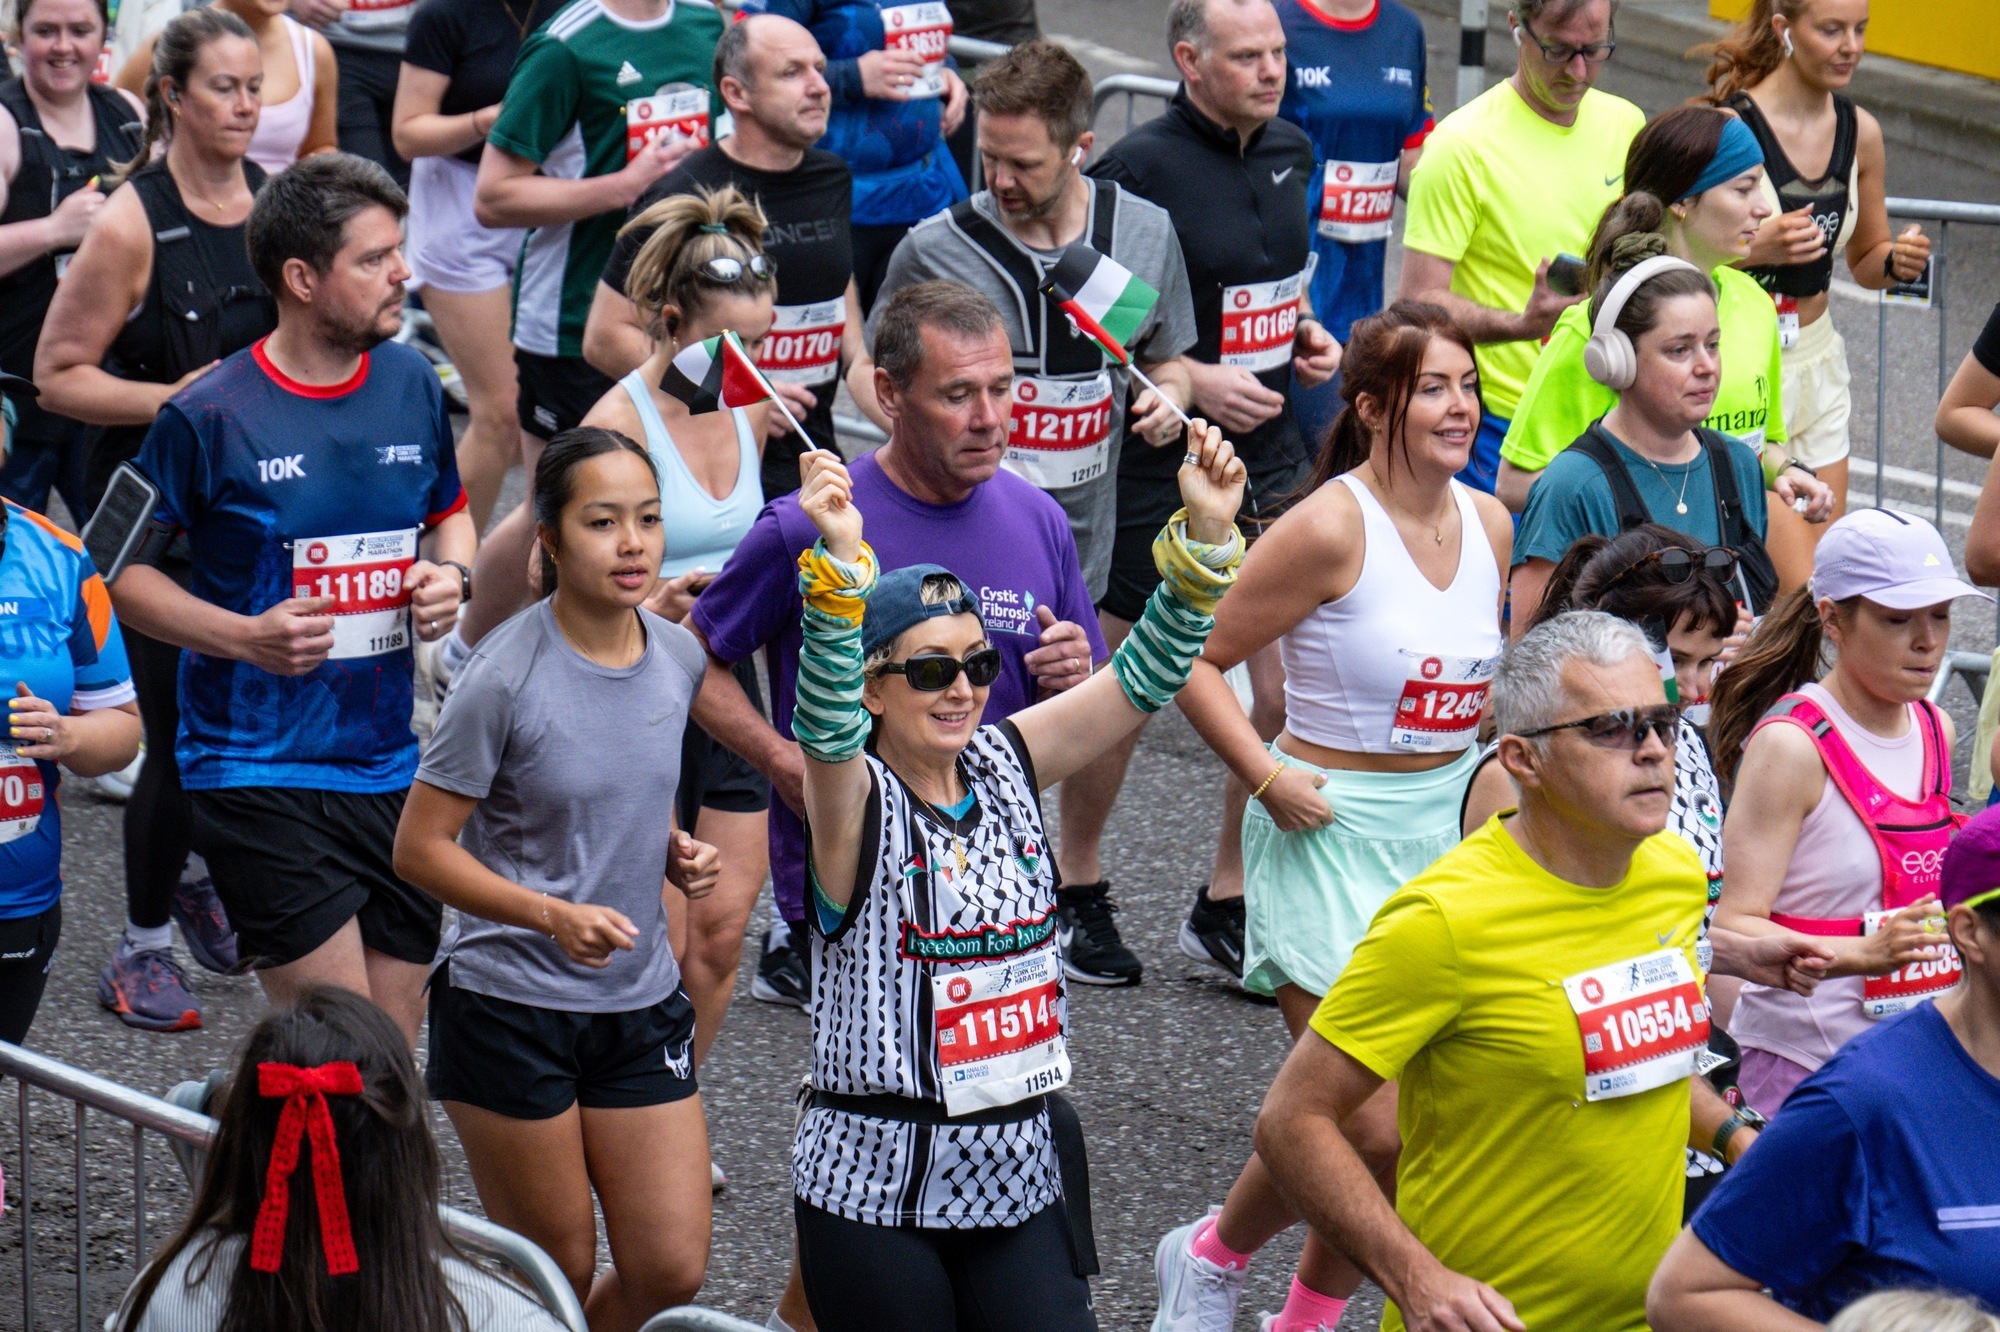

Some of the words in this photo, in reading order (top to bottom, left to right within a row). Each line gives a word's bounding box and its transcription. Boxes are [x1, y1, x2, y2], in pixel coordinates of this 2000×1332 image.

[1295, 65, 1332, 88] 10K
[1241, 305, 1297, 343] 10169
[762, 331, 834, 361] 10170
[1022, 407, 1102, 440] 12171
[257, 454, 307, 483] 10K
[1071, 463, 1102, 483] 12171
[310, 548, 325, 560] 10K
[315, 567, 402, 602] 11189
[980, 586, 1019, 604] Cystic
[982, 601, 1031, 621] Fibrosis
[984, 617, 1014, 629] reland
[369, 632, 403, 652] 11189
[1424, 662, 1439, 675] 10K
[1422, 689, 1488, 719] 1245
[1912, 872, 1941, 884] ELITE
[1014, 968, 1030, 979] CORK
[1029, 963, 1045, 973] CITY
[1014, 969, 1048, 986] MARATHON
[1642, 968, 1660, 978] CORK
[1644, 970, 1679, 985] MARATHON
[951, 983, 967, 998] 10K
[959, 994, 1049, 1047] 11514
[1602, 995, 1692, 1053] 10554
[966, 1065, 989, 1074] ANALOG
[966, 1070, 990, 1080] DEVICES
[1025, 1066, 1064, 1093] 11514
